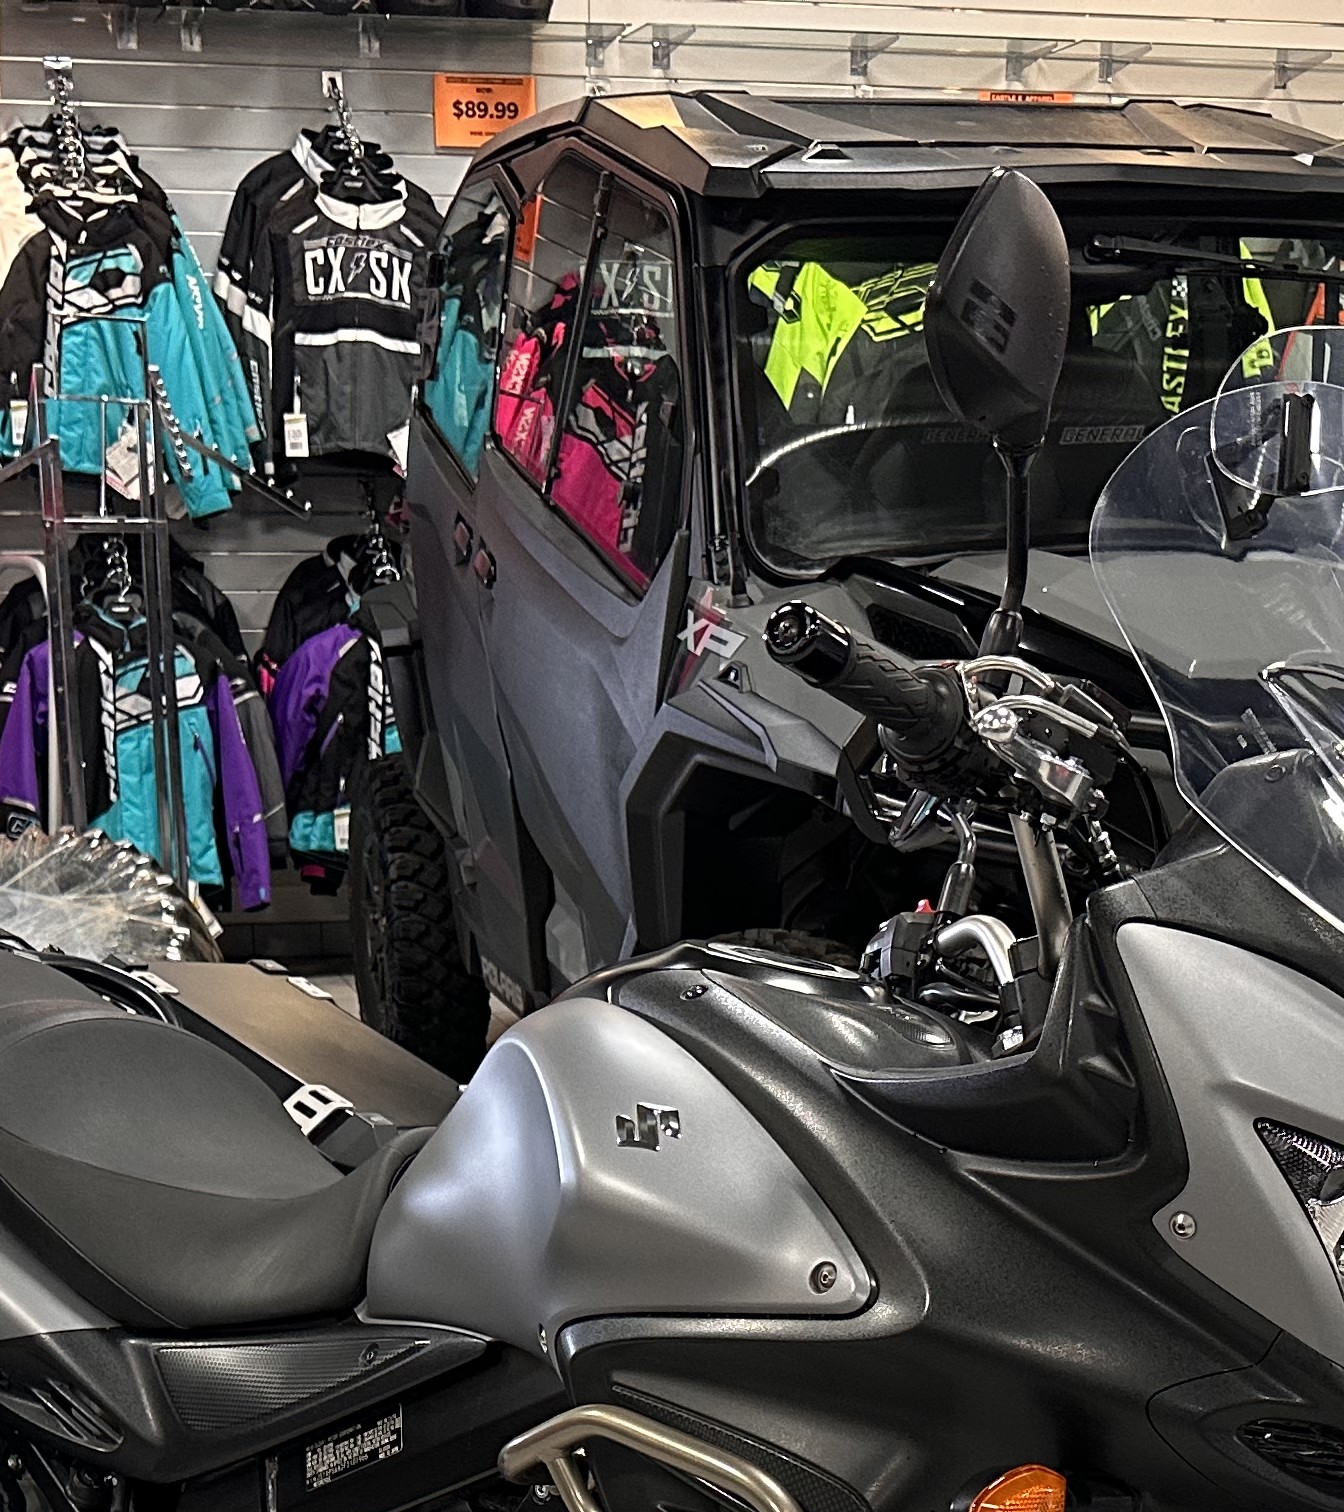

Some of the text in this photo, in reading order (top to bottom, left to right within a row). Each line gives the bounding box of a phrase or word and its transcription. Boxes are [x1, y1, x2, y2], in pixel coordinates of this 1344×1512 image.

[453, 99, 519, 120] $89.99
[1059, 424, 1146, 444] GENERAL
[676, 609, 748, 659] XP
